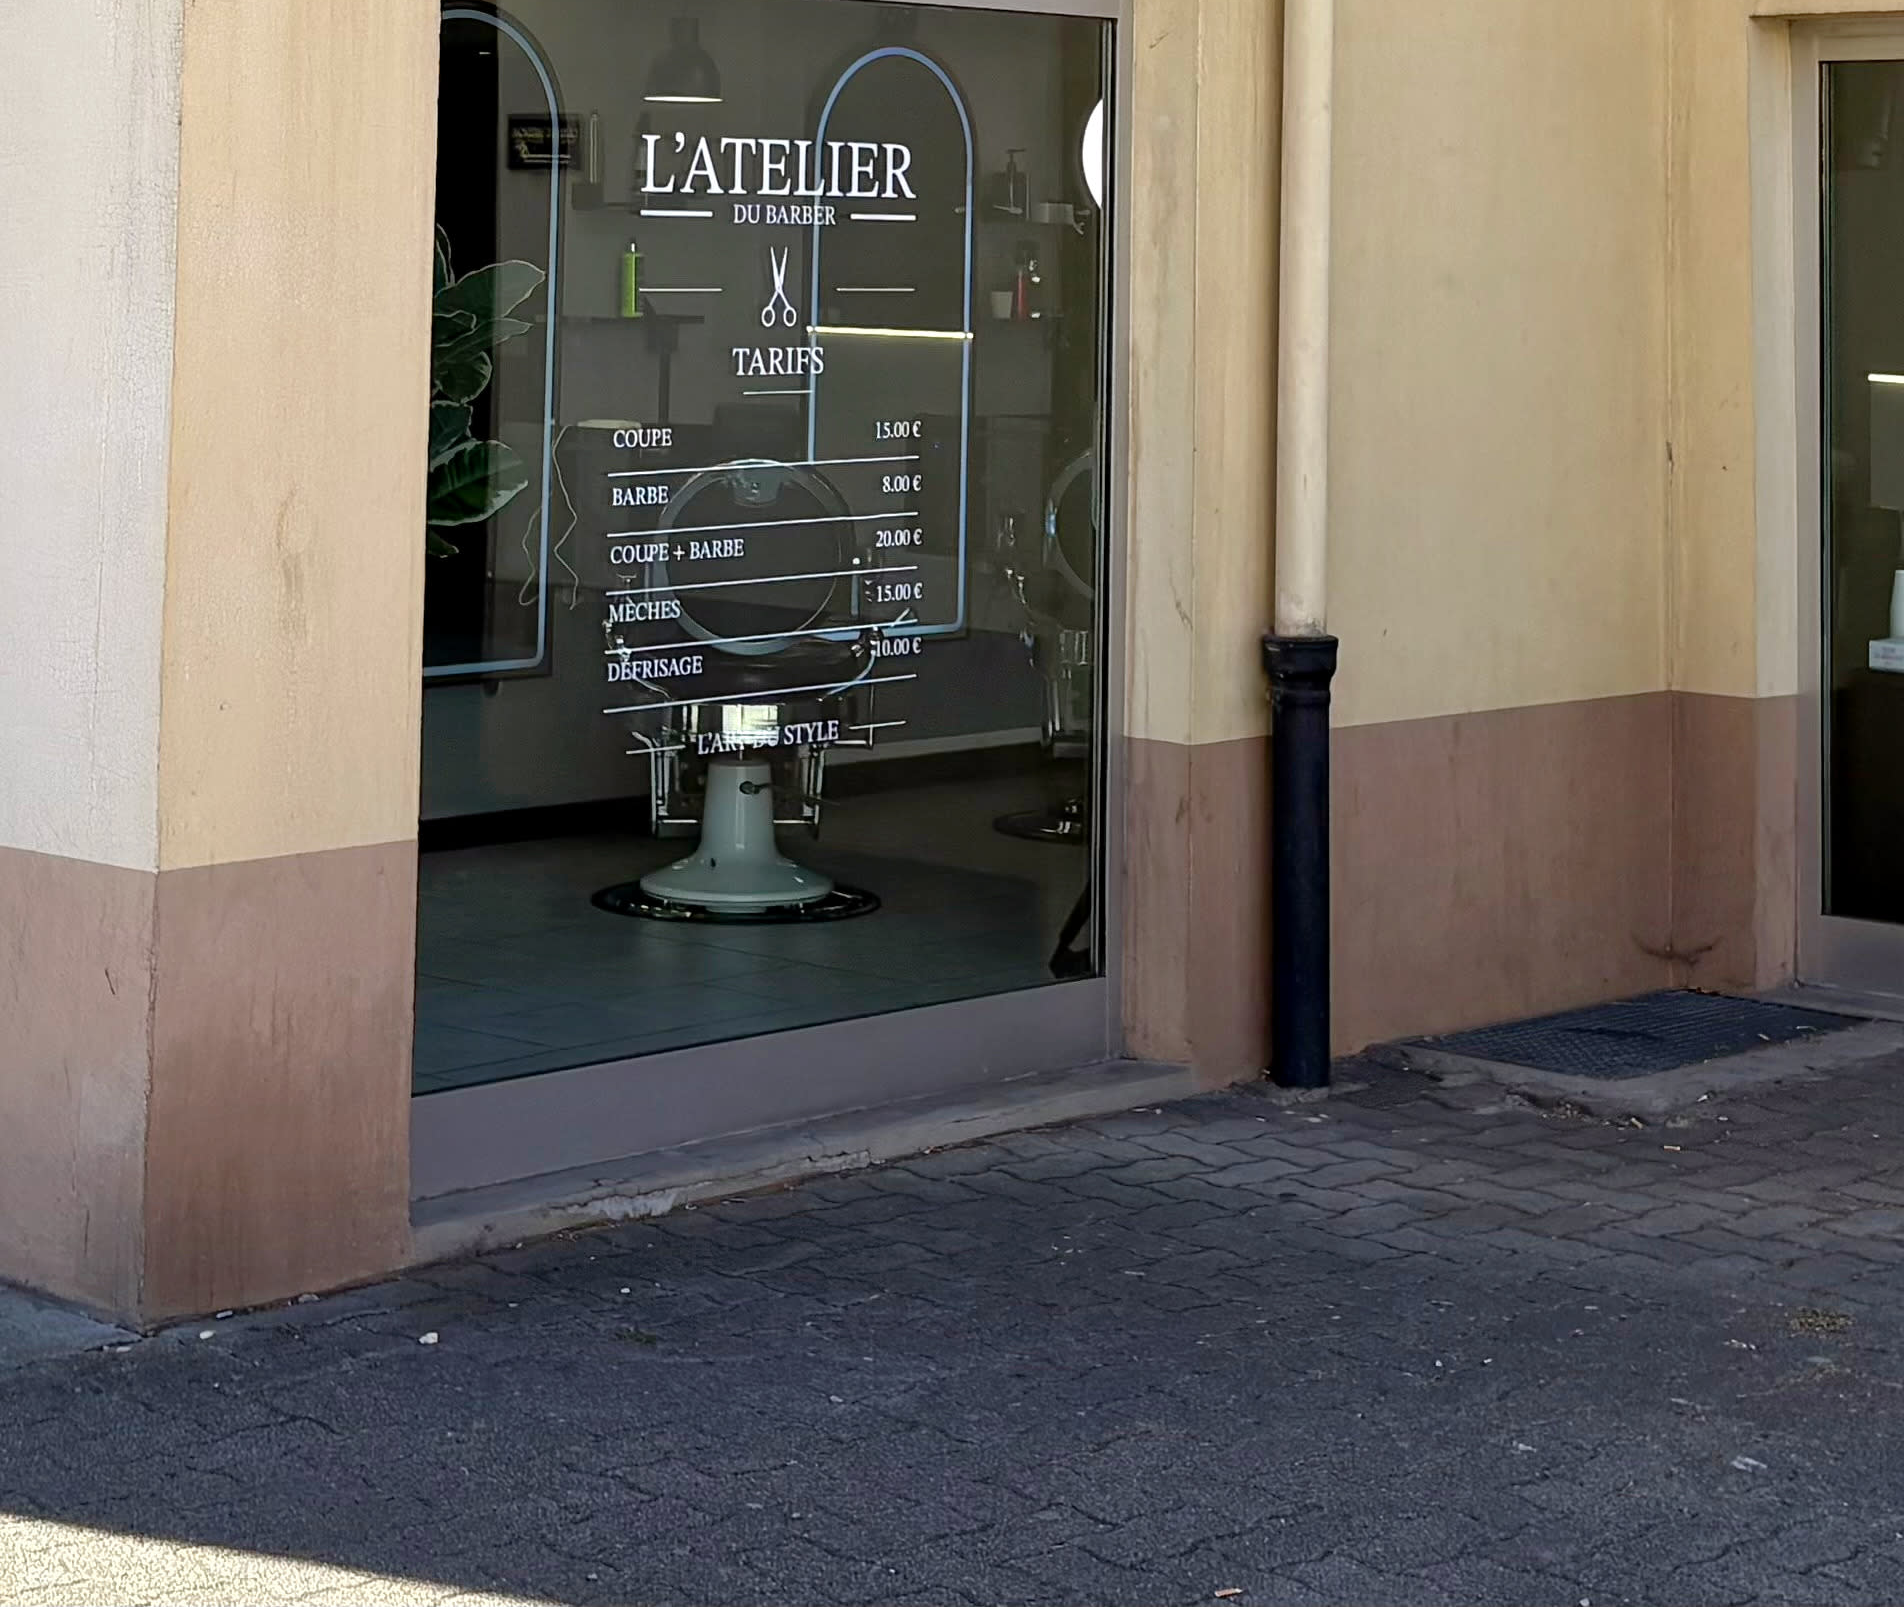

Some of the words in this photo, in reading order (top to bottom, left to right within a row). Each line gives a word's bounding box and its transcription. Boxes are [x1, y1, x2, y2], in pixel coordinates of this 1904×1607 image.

[640, 131, 917, 199] L'ATELIER
[733, 204, 760, 224] DU
[766, 205, 836, 226] BARBER
[733, 347, 824, 376] TARIFS
[613, 428, 673, 448] COUPE
[876, 422, 911, 439] 15.00
[912, 420, 921, 437] €
[882, 476, 911, 493] 8.00
[912, 474, 922, 491] €
[612, 486, 669, 507] BARBE
[876, 530, 911, 548] 20.00
[913, 528, 923, 545] €
[610, 543, 670, 565] COUPE
[673, 545, 686, 561] +
[689, 538, 745, 560] BARBE
[877, 584, 911, 603] 15.00
[913, 582, 923, 599] €
[608, 598, 681, 624] MÈCHES
[875, 639, 911, 657] 10.00
[912, 637, 922, 654] €
[607, 655, 704, 682] DÉFRISAGE
[783, 720, 840, 745] STYLE
